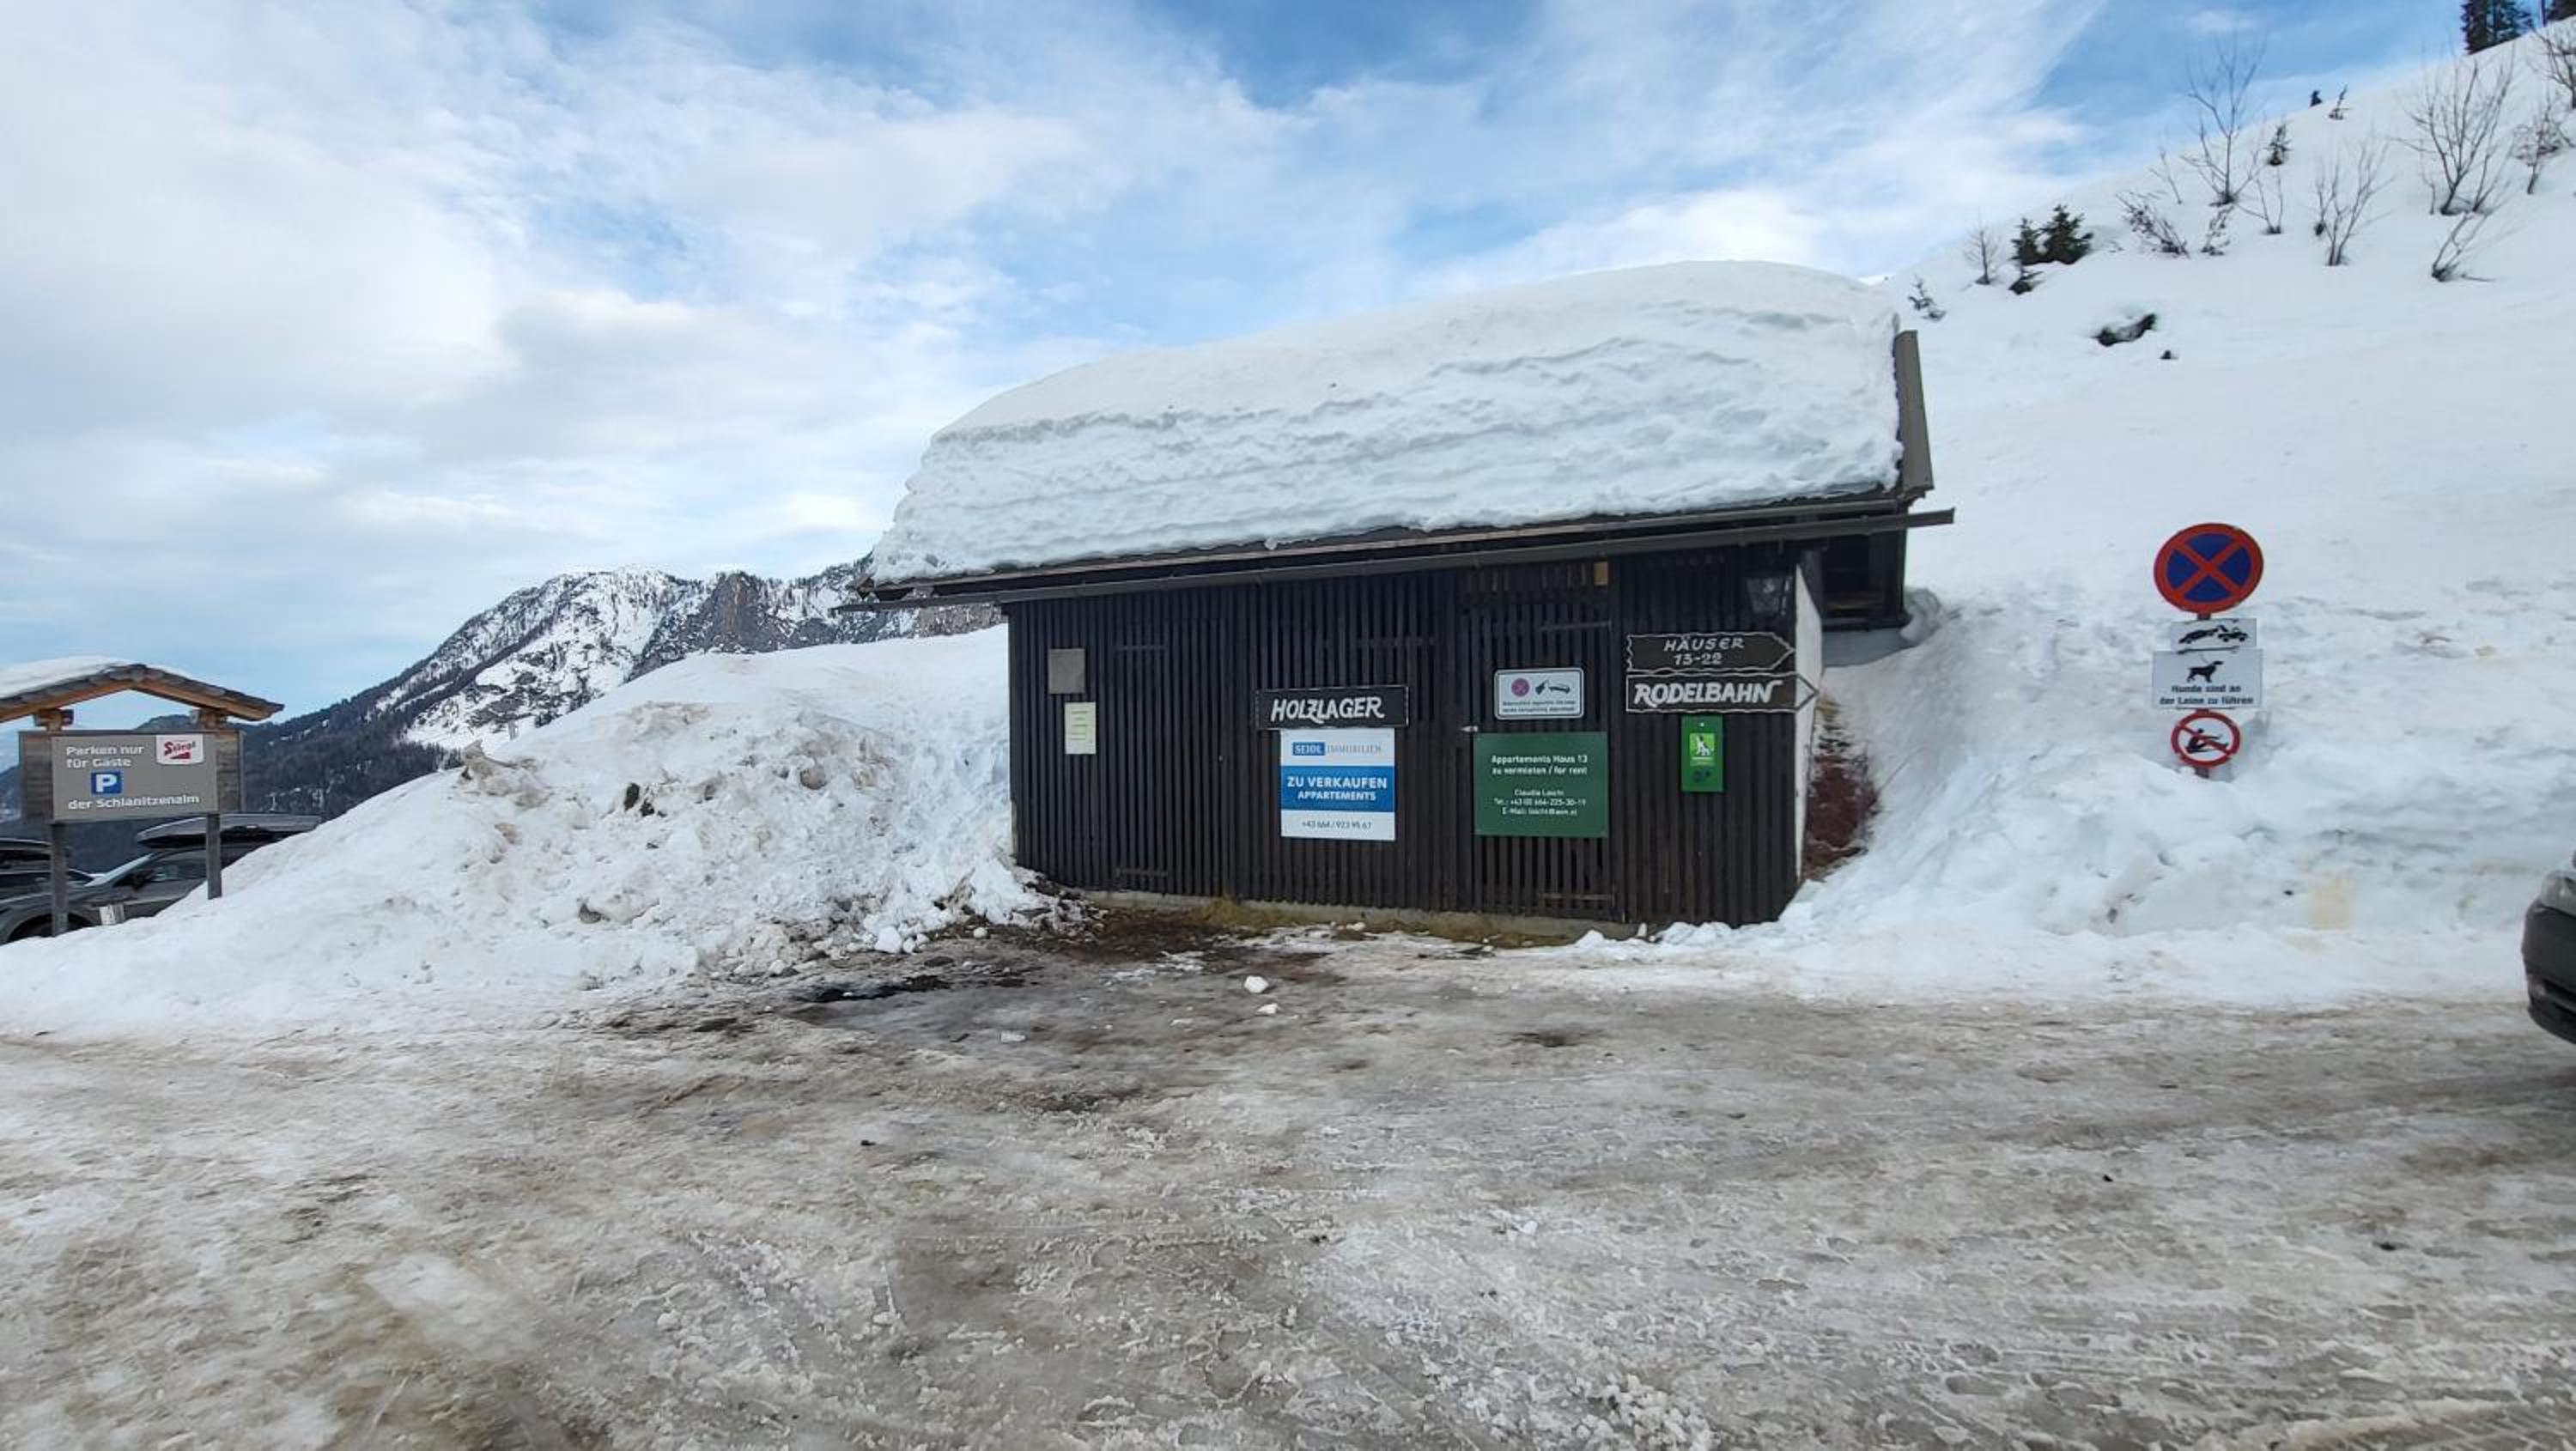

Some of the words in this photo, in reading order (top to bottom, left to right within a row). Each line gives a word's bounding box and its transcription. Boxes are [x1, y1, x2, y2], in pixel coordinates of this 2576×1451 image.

[1663, 634, 1745, 652] HÄUSER
[1633, 680, 1783, 707] RODELBAHN
[1270, 696, 1385, 724] HOLZLAGER
[66, 746, 117, 756] Parken
[120, 745, 144, 755] nur
[66, 758, 88, 768] für
[1492, 755, 1551, 765] Appartements
[1552, 755, 1576, 763] Haus
[1554, 766, 1567, 774] for
[95, 774, 117, 792] P
[1288, 776, 1303, 787] ZU
[1308, 776, 1387, 789] VERKAUFEN
[68, 798, 92, 810] der
[96, 794, 199, 808] Schlanitzenalm
[1297, 791, 1376, 801] APPARTEMENTS
